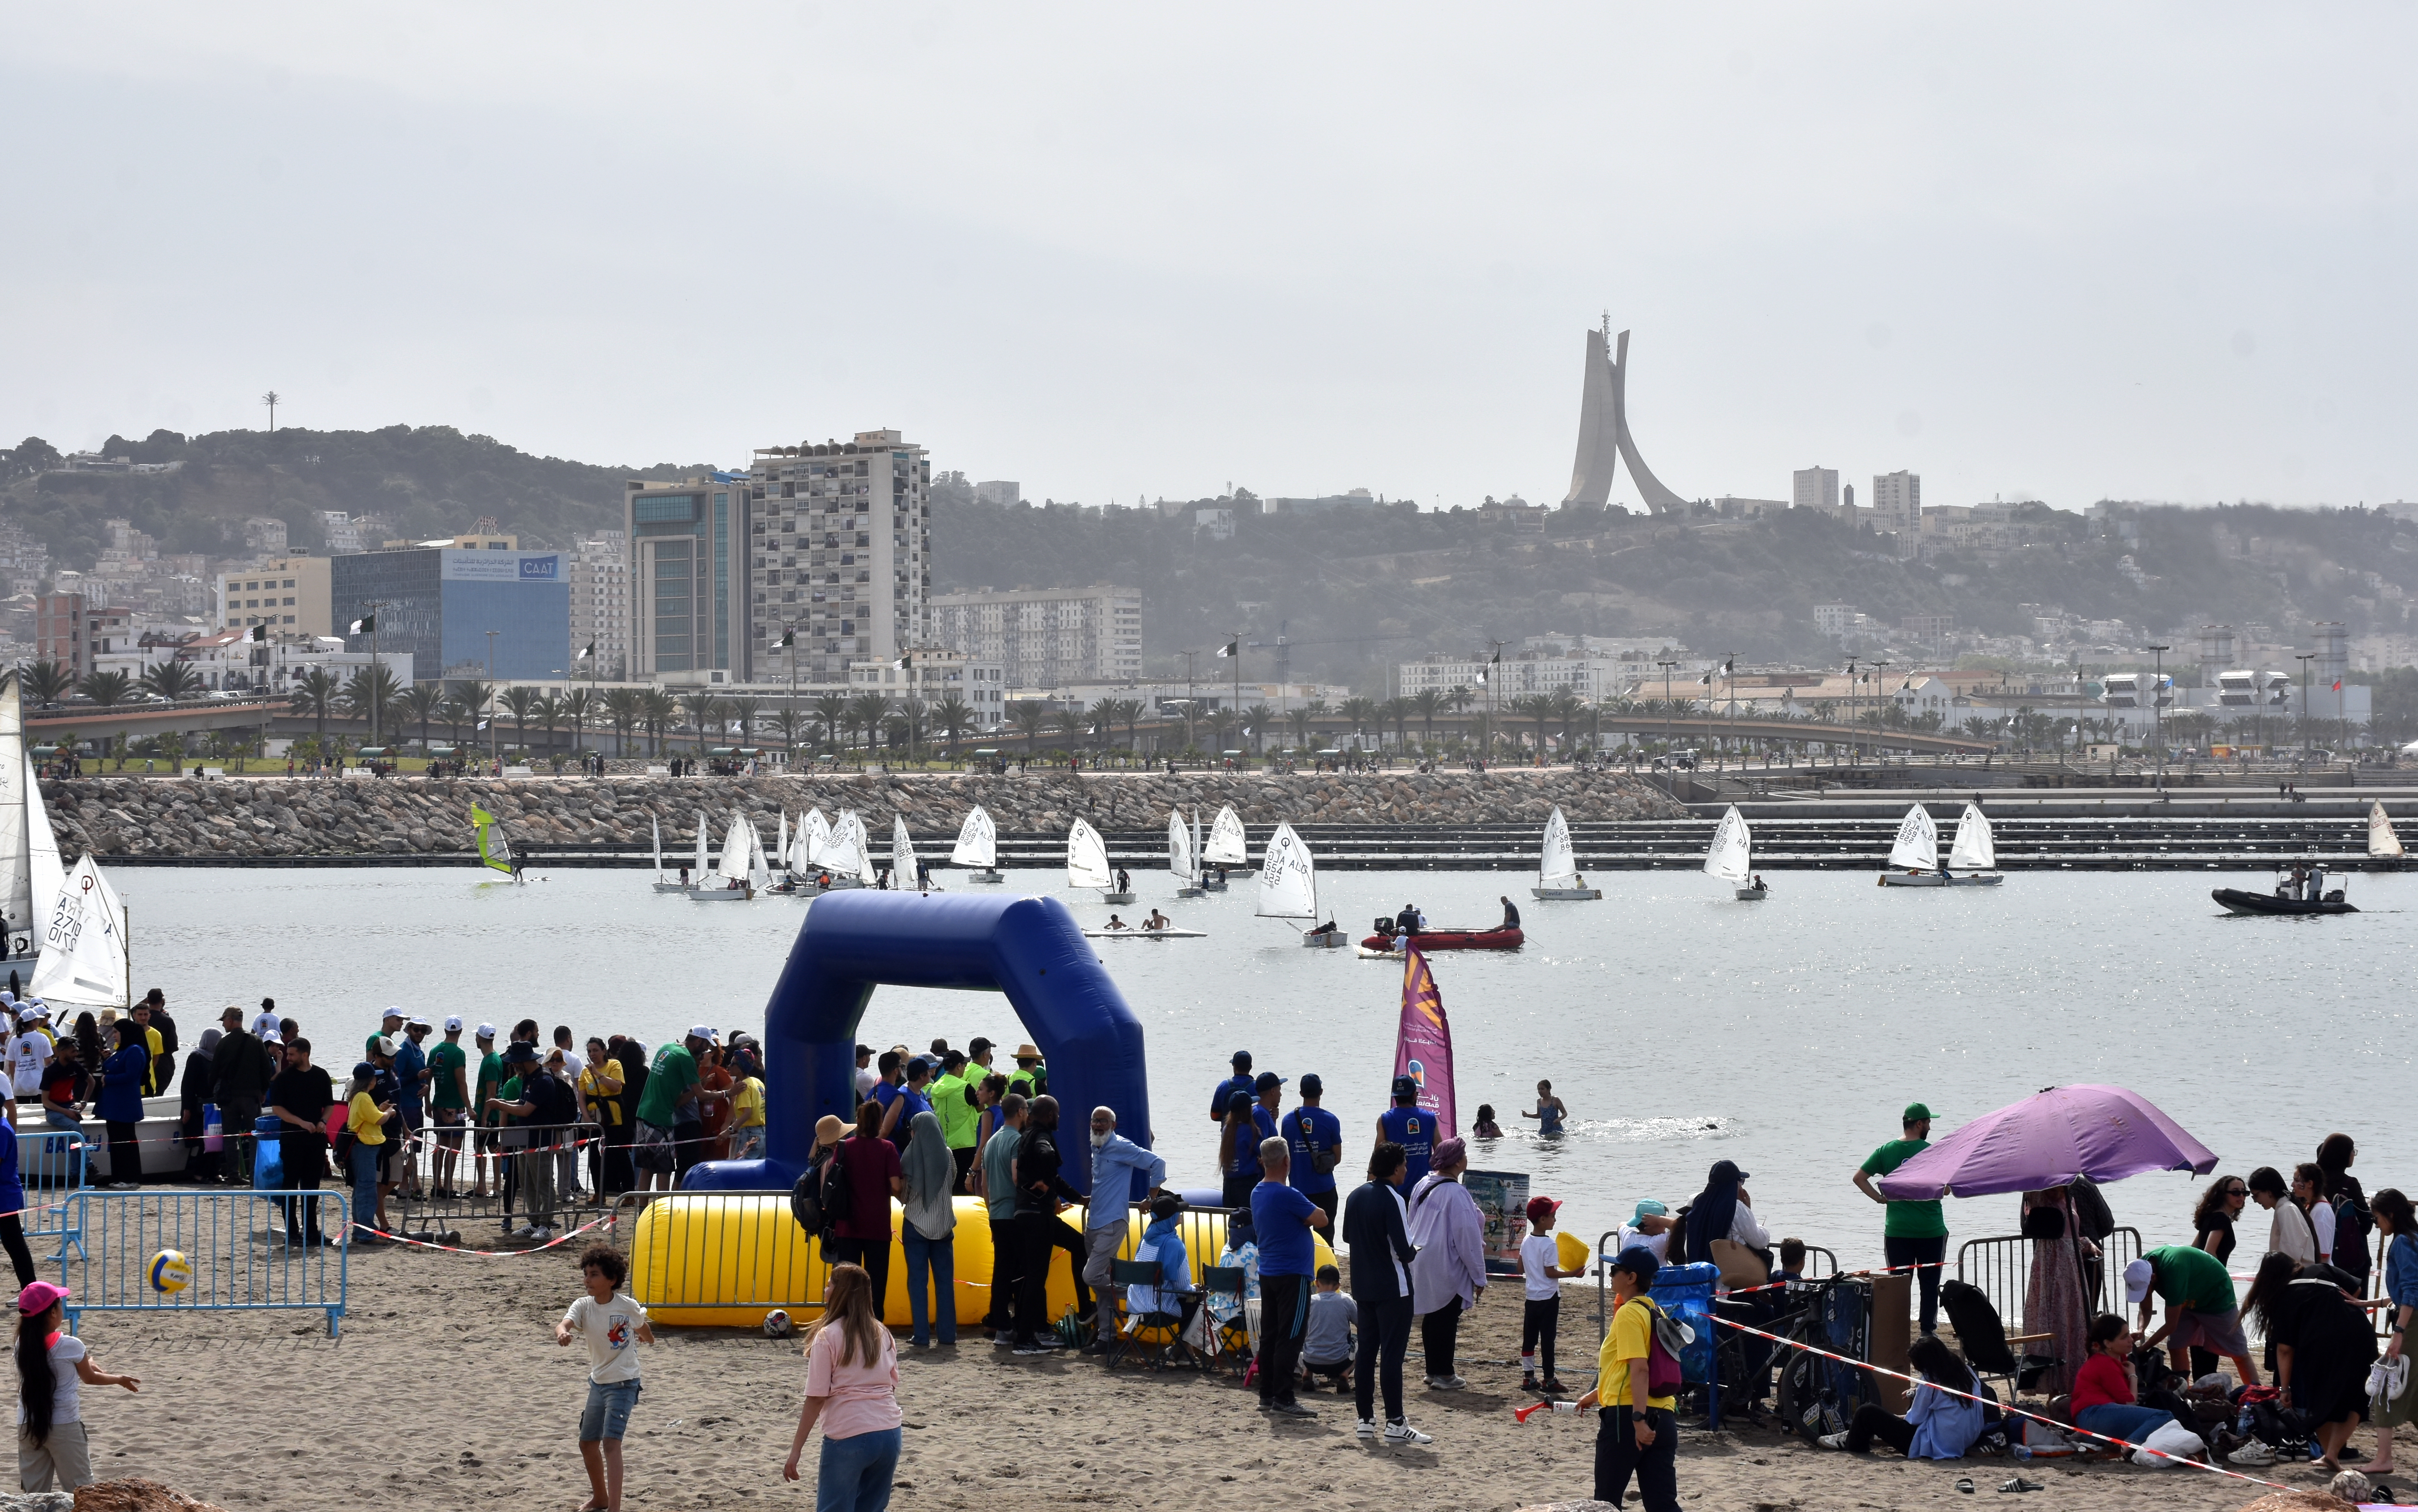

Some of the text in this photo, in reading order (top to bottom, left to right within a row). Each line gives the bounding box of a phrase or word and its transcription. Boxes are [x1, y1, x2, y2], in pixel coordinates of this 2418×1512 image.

[524, 562, 553, 574] CAAT
[980, 831, 992, 841] ALG
[1227, 827, 1240, 837] ALG
[1553, 829, 1564, 840] ALG
[1921, 830, 1933, 841] ALG
[1266, 862, 1283, 875] 554
[1289, 860, 1308, 874] ALG
[53, 912, 82, 937] 2710
